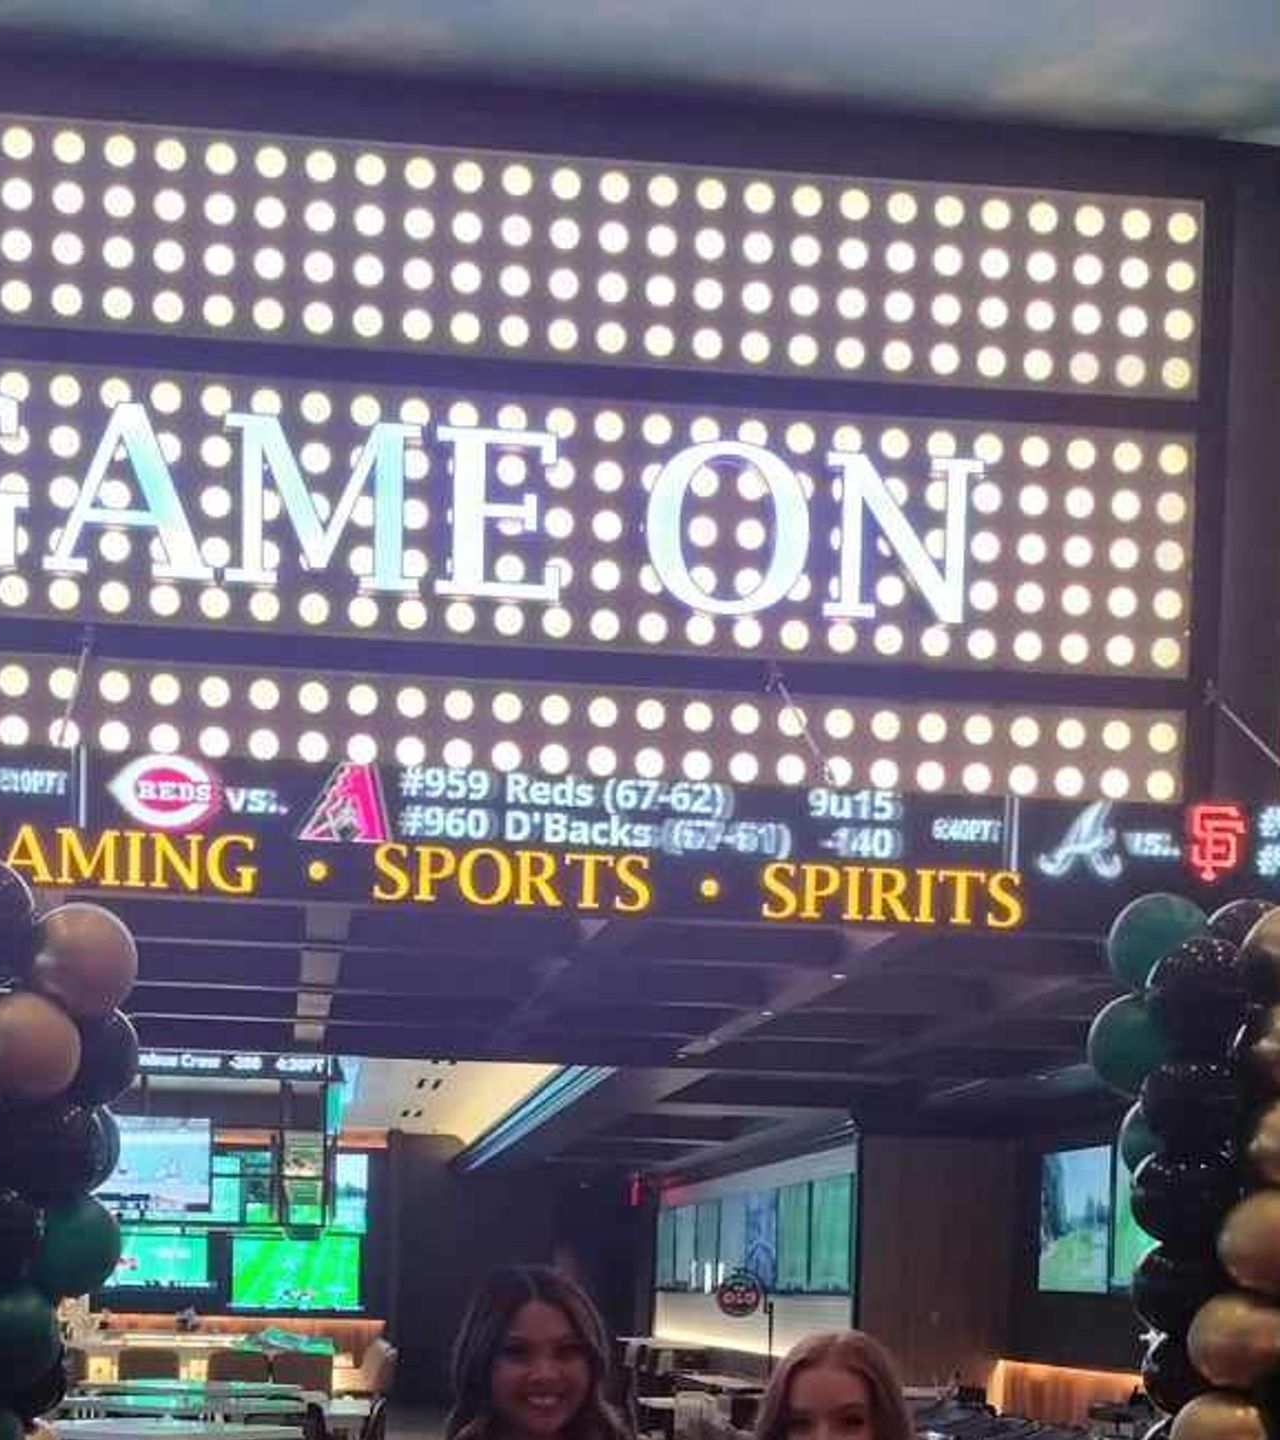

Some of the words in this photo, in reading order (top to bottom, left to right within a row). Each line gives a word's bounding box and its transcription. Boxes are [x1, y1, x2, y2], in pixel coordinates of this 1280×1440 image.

[645, 438, 988, 626] ON
[136, 780, 211, 801] REDS
[399, 765, 490, 800] #959
[506, 773, 595, 807] Reds
[604, 777, 732, 818] (67-62)
[399, 804, 490, 839] #960
[504, 810, 653, 849] D'Backs
[373, 843, 652, 912] SPORTS
[762, 863, 1023, 928] SPIRITS
